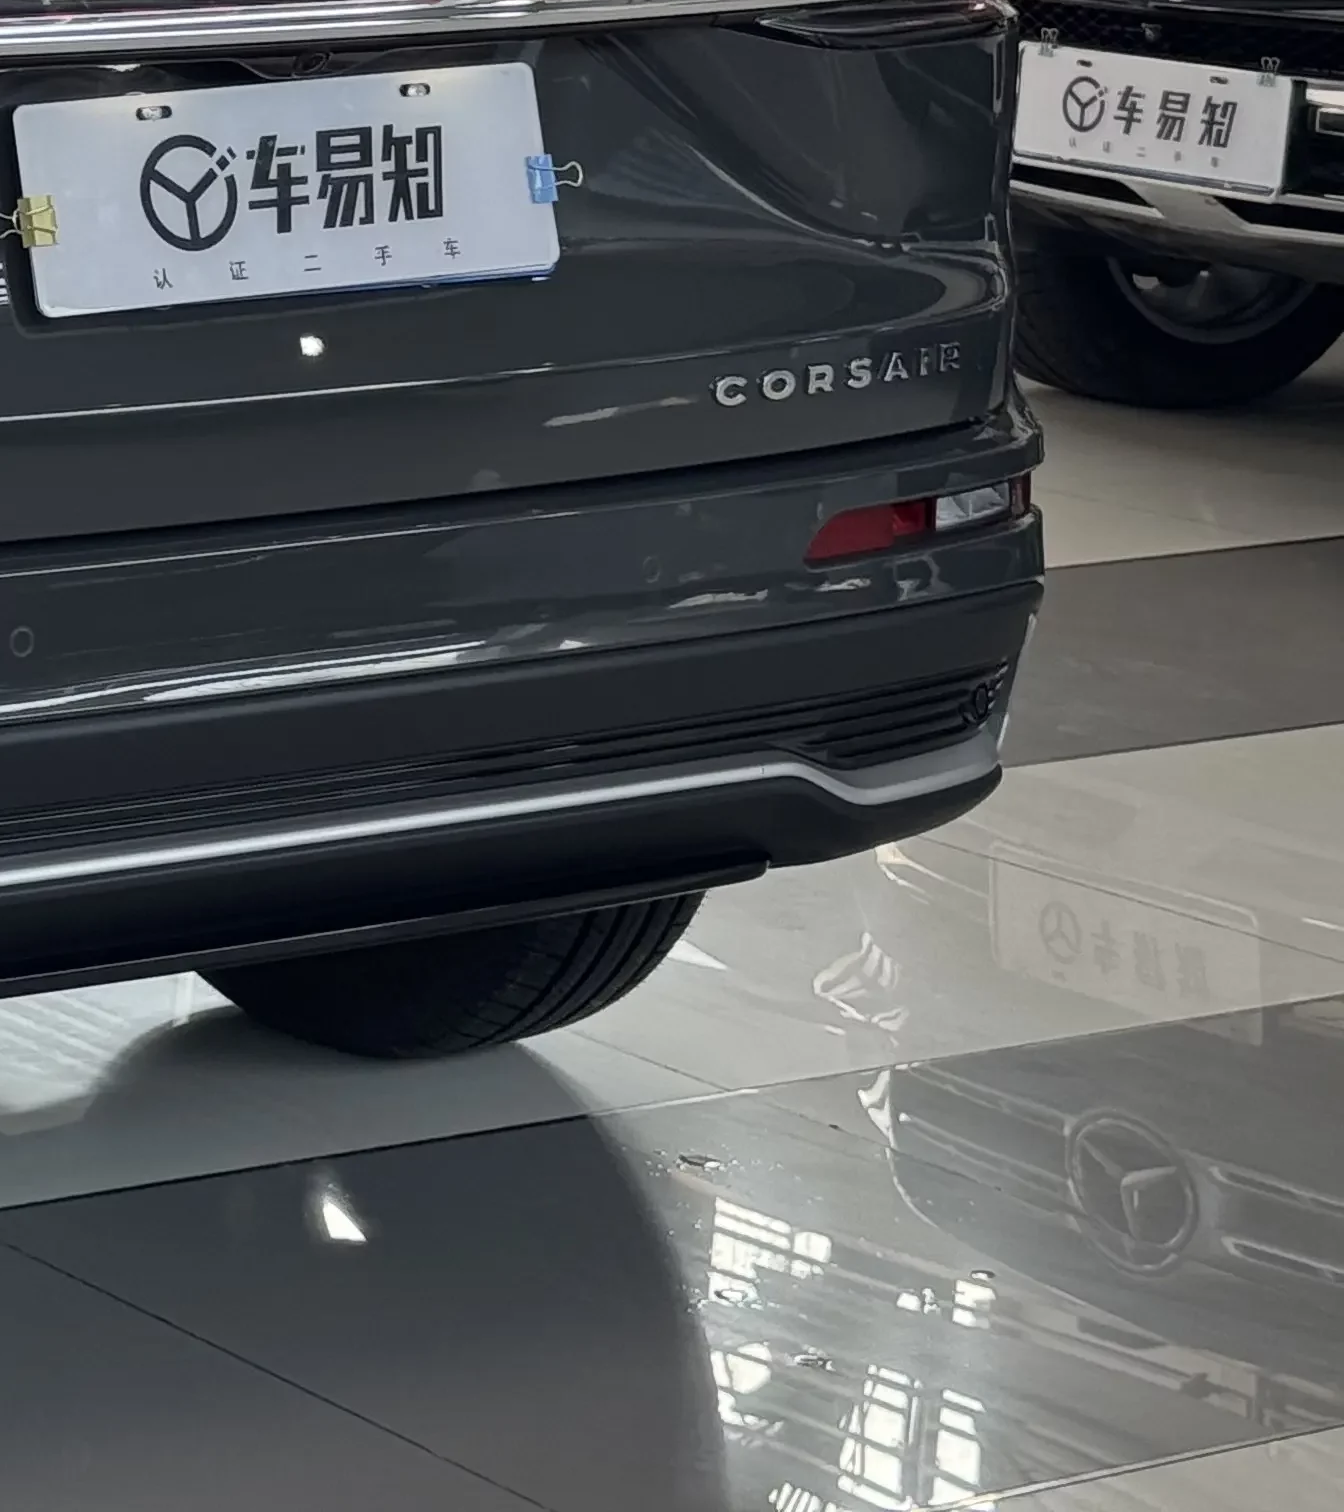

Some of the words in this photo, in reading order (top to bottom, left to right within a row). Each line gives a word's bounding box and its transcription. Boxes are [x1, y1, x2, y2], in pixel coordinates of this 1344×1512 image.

[1113, 84, 1238, 149] 车易知
[246, 123, 443, 234] 车易知
[153, 237, 462, 290] 认证二手车
[712, 341, 962, 408] CORSAIR
